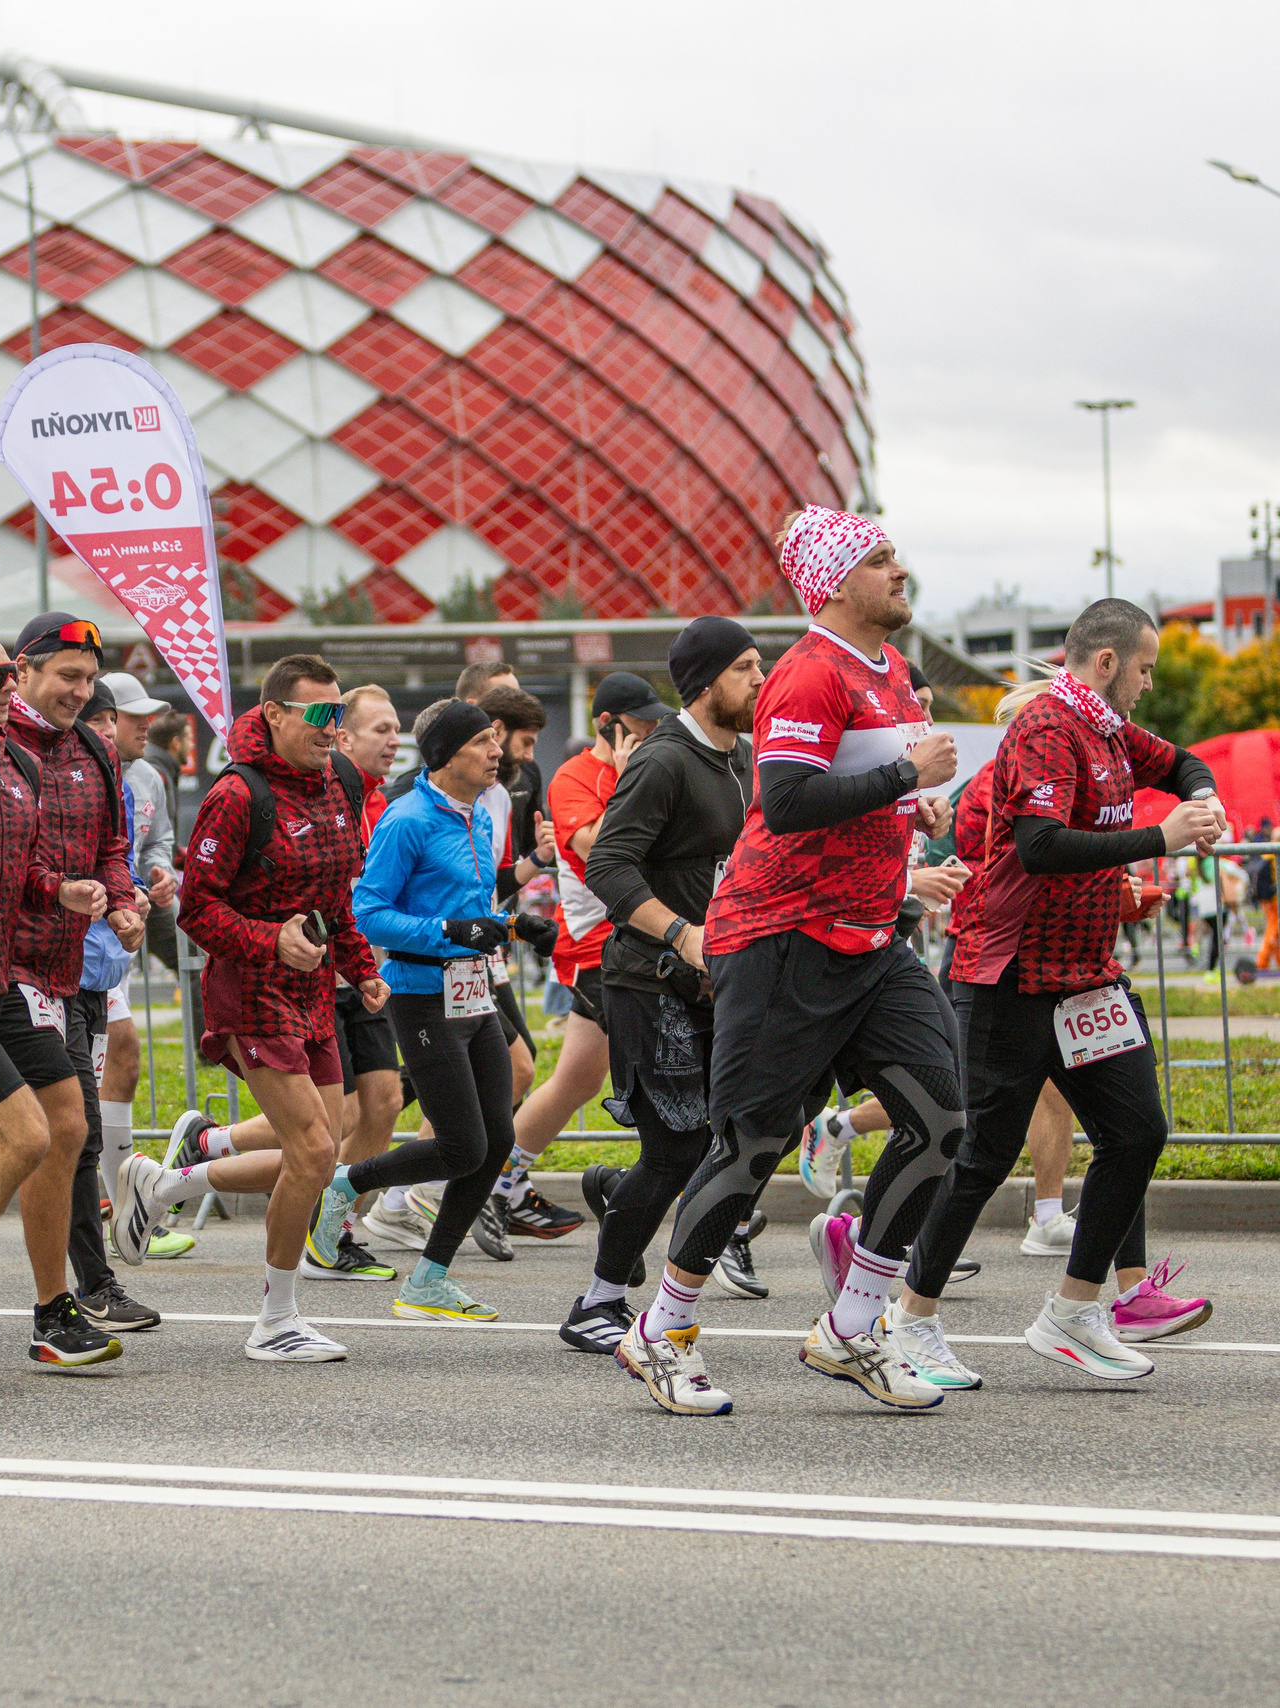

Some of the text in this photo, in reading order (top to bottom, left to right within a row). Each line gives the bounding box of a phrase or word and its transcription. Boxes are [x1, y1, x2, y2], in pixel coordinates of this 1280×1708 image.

[1038, 785, 1054, 795] 35
[1094, 798, 1134, 825] ЛУКОЙ
[452, 979, 485, 1001] 2740
[1064, 1003, 1128, 1040] 1656
